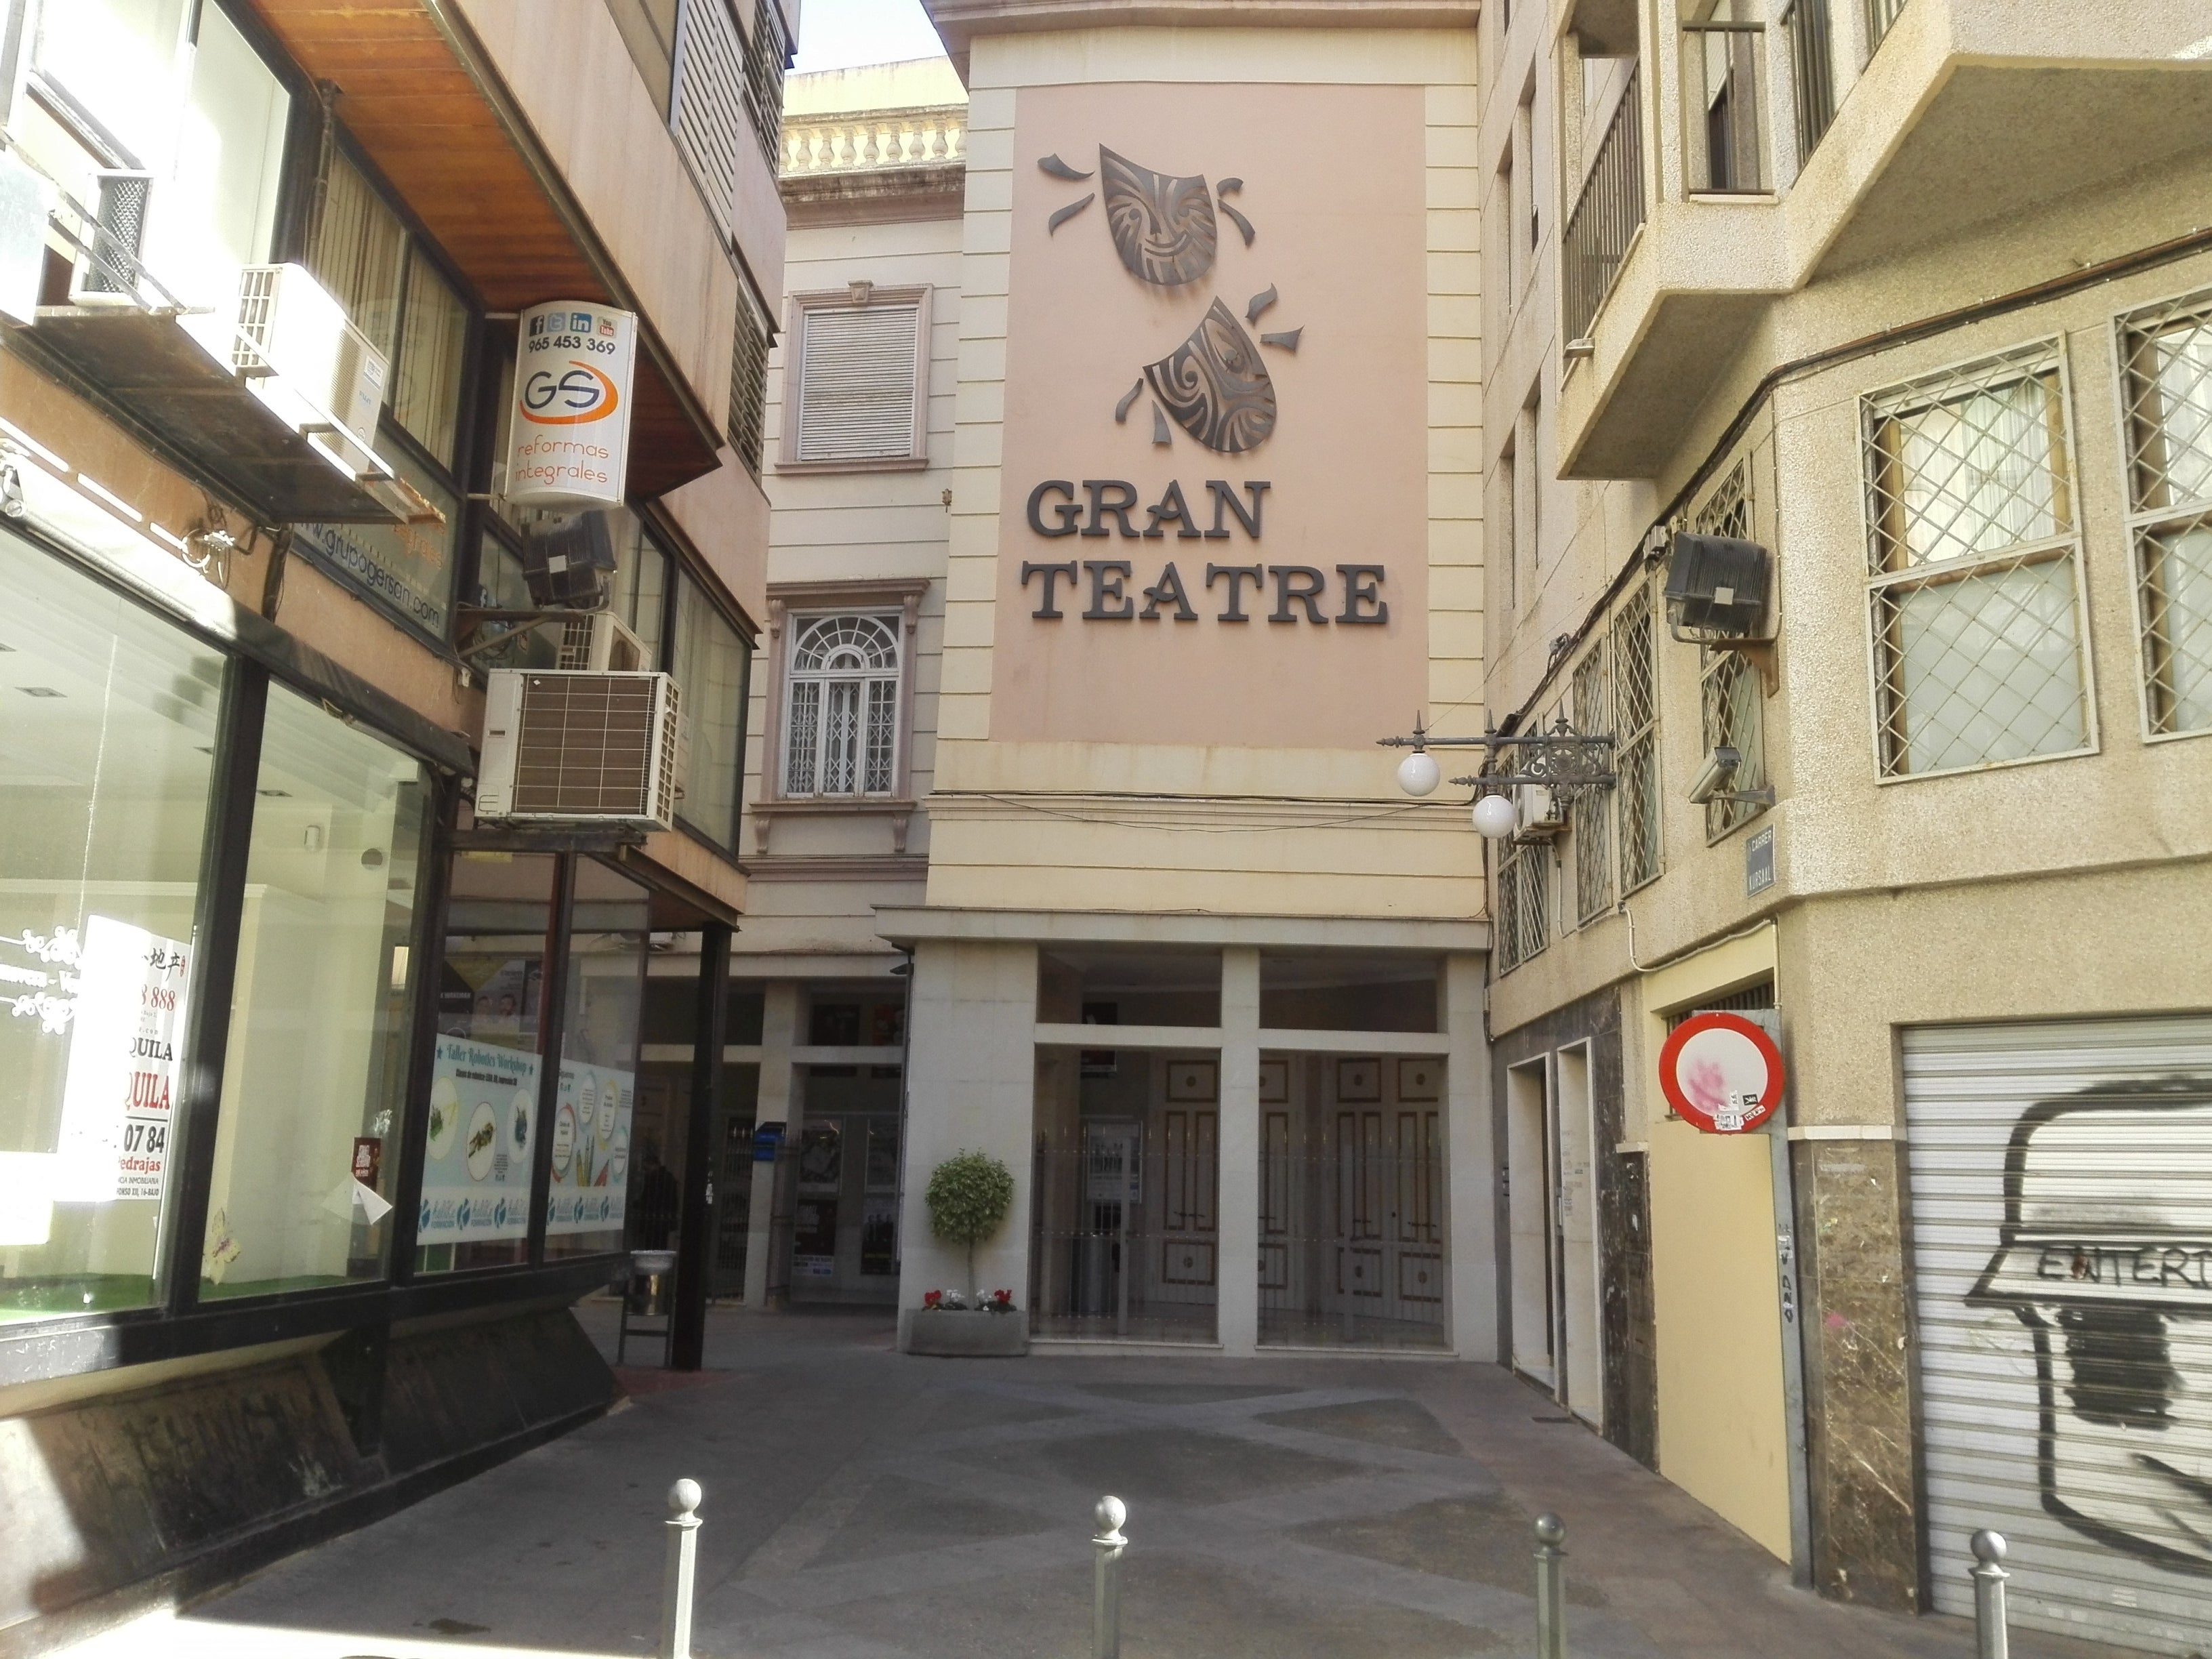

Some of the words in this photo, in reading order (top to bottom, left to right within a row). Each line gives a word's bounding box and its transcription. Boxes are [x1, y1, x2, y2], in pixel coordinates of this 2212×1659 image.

[529, 337, 550, 352] 965
[553, 335, 581, 348] 453
[586, 338, 615, 354] 369
[525, 370, 600, 409] GS
[518, 434, 609, 458] reformas
[515, 460, 607, 485] integrales
[1027, 479, 1271, 538] GRAN
[301, 523, 440, 628] w.grupogersan.com
[1021, 560, 1389, 624] TEATRE
[1752, 830, 1771, 852] CARRER
[142, 947, 180, 981] 地产
[150, 987, 175, 1010] 888
[124, 1124, 144, 1151] 07
[146, 1126, 165, 1153] 84
[118, 1155, 161, 1174] edrajas
